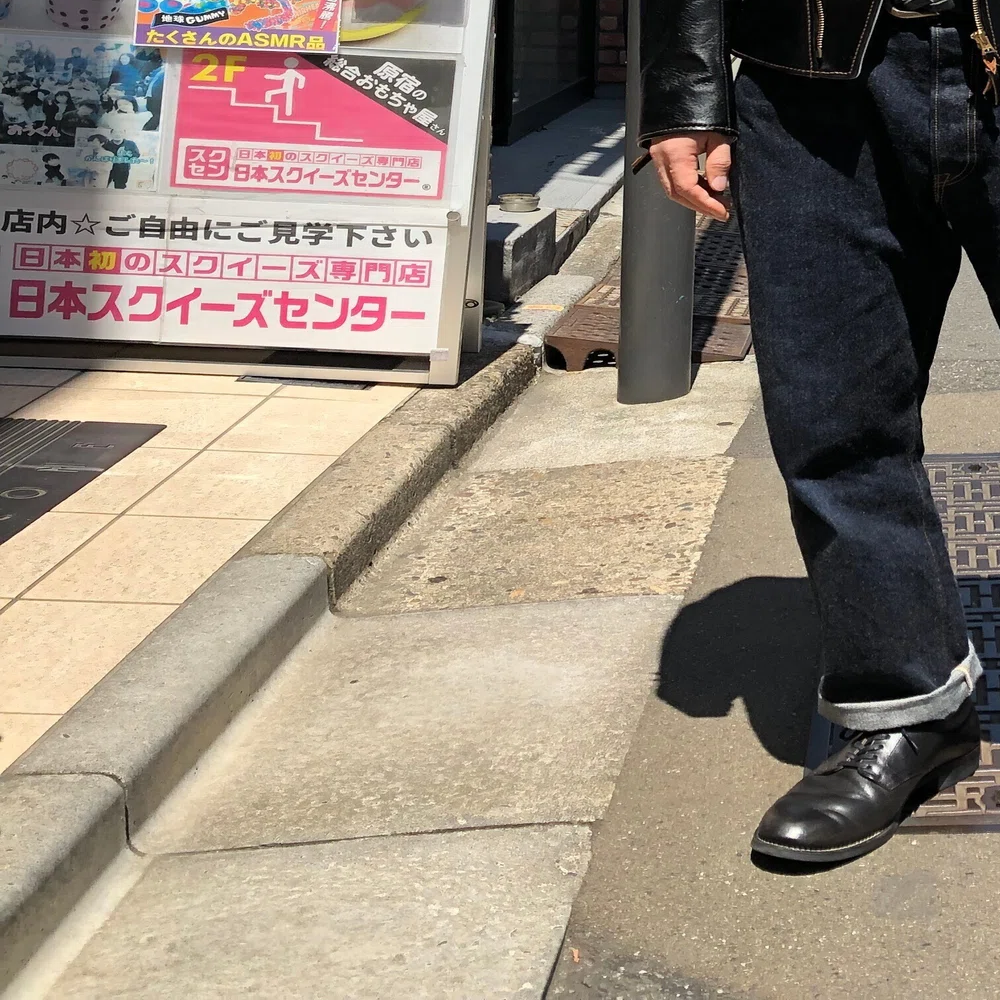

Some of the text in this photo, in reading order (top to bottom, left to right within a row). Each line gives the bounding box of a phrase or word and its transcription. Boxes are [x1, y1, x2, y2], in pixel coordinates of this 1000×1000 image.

[146, 29, 326, 50] たくさんのASMR品
[190, 53, 248, 83] 2F
[373, 61, 428, 100] 原宿の
[237, 149, 421, 168] 日本初のスクイーズ専門店
[233, 164, 420, 189] 日本スクイーズセンター
[19, 247, 427, 284] 日本初のスクイーズ専門店
[9, 279, 426, 332] 日本スクイーズセンター
